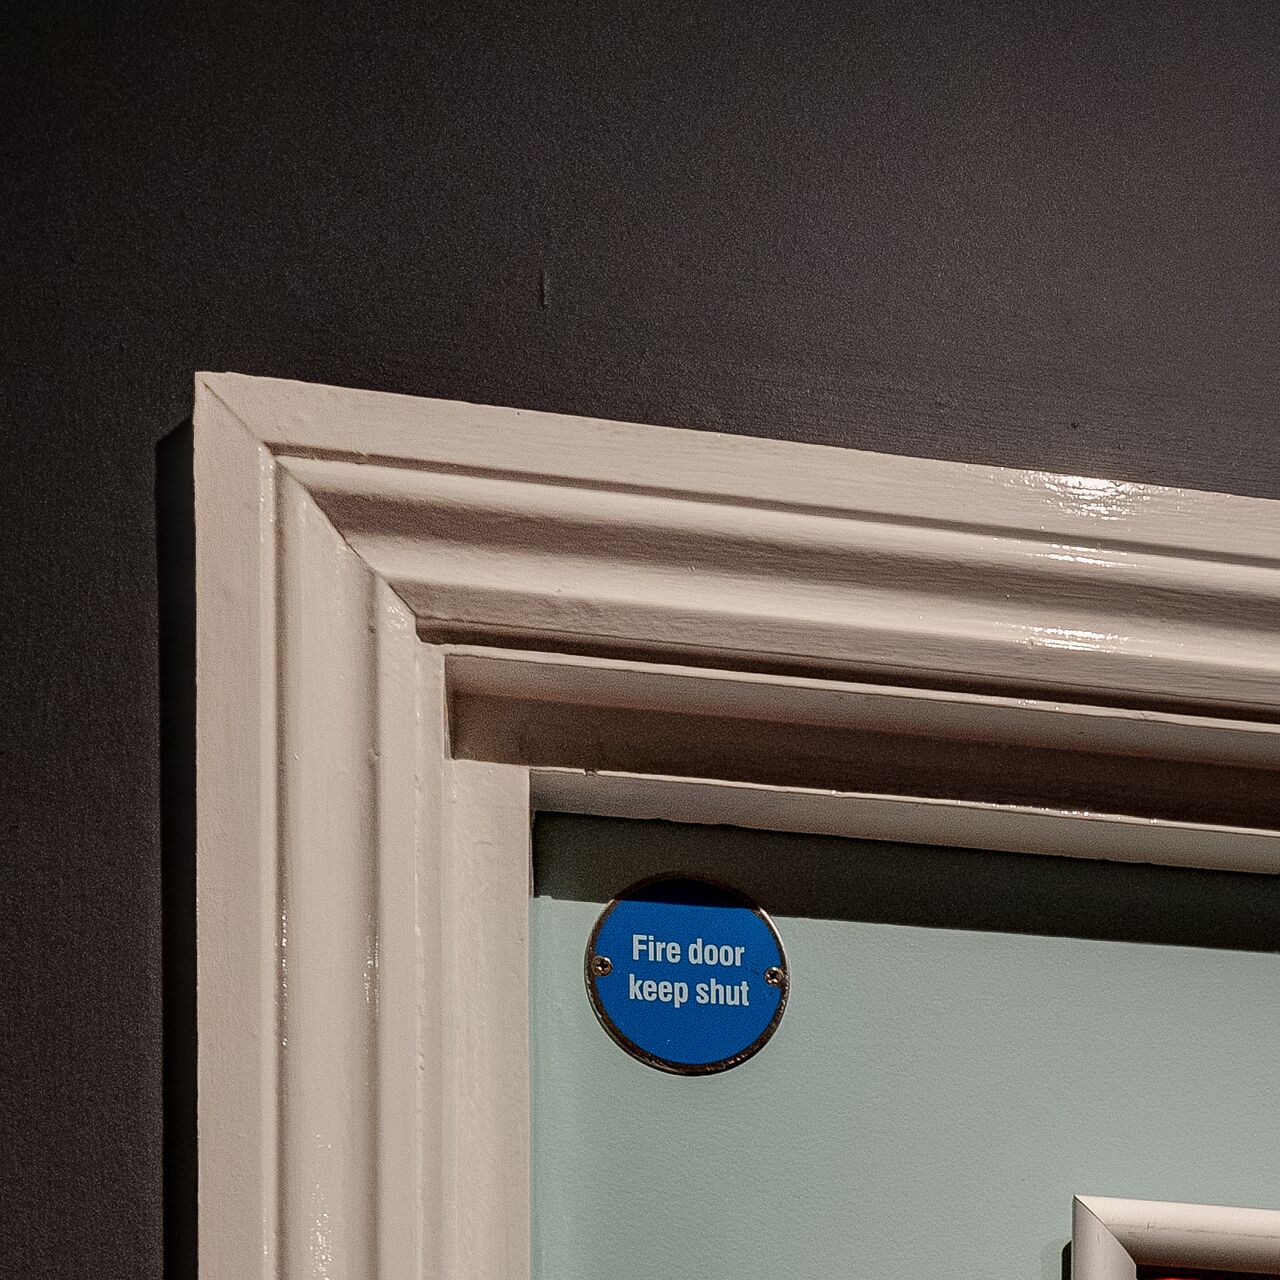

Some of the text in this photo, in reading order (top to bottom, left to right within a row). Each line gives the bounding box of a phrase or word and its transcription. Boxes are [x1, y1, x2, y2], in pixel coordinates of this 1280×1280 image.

[632, 934, 745, 966] Fire door
[629, 973, 749, 1008] keep shut
